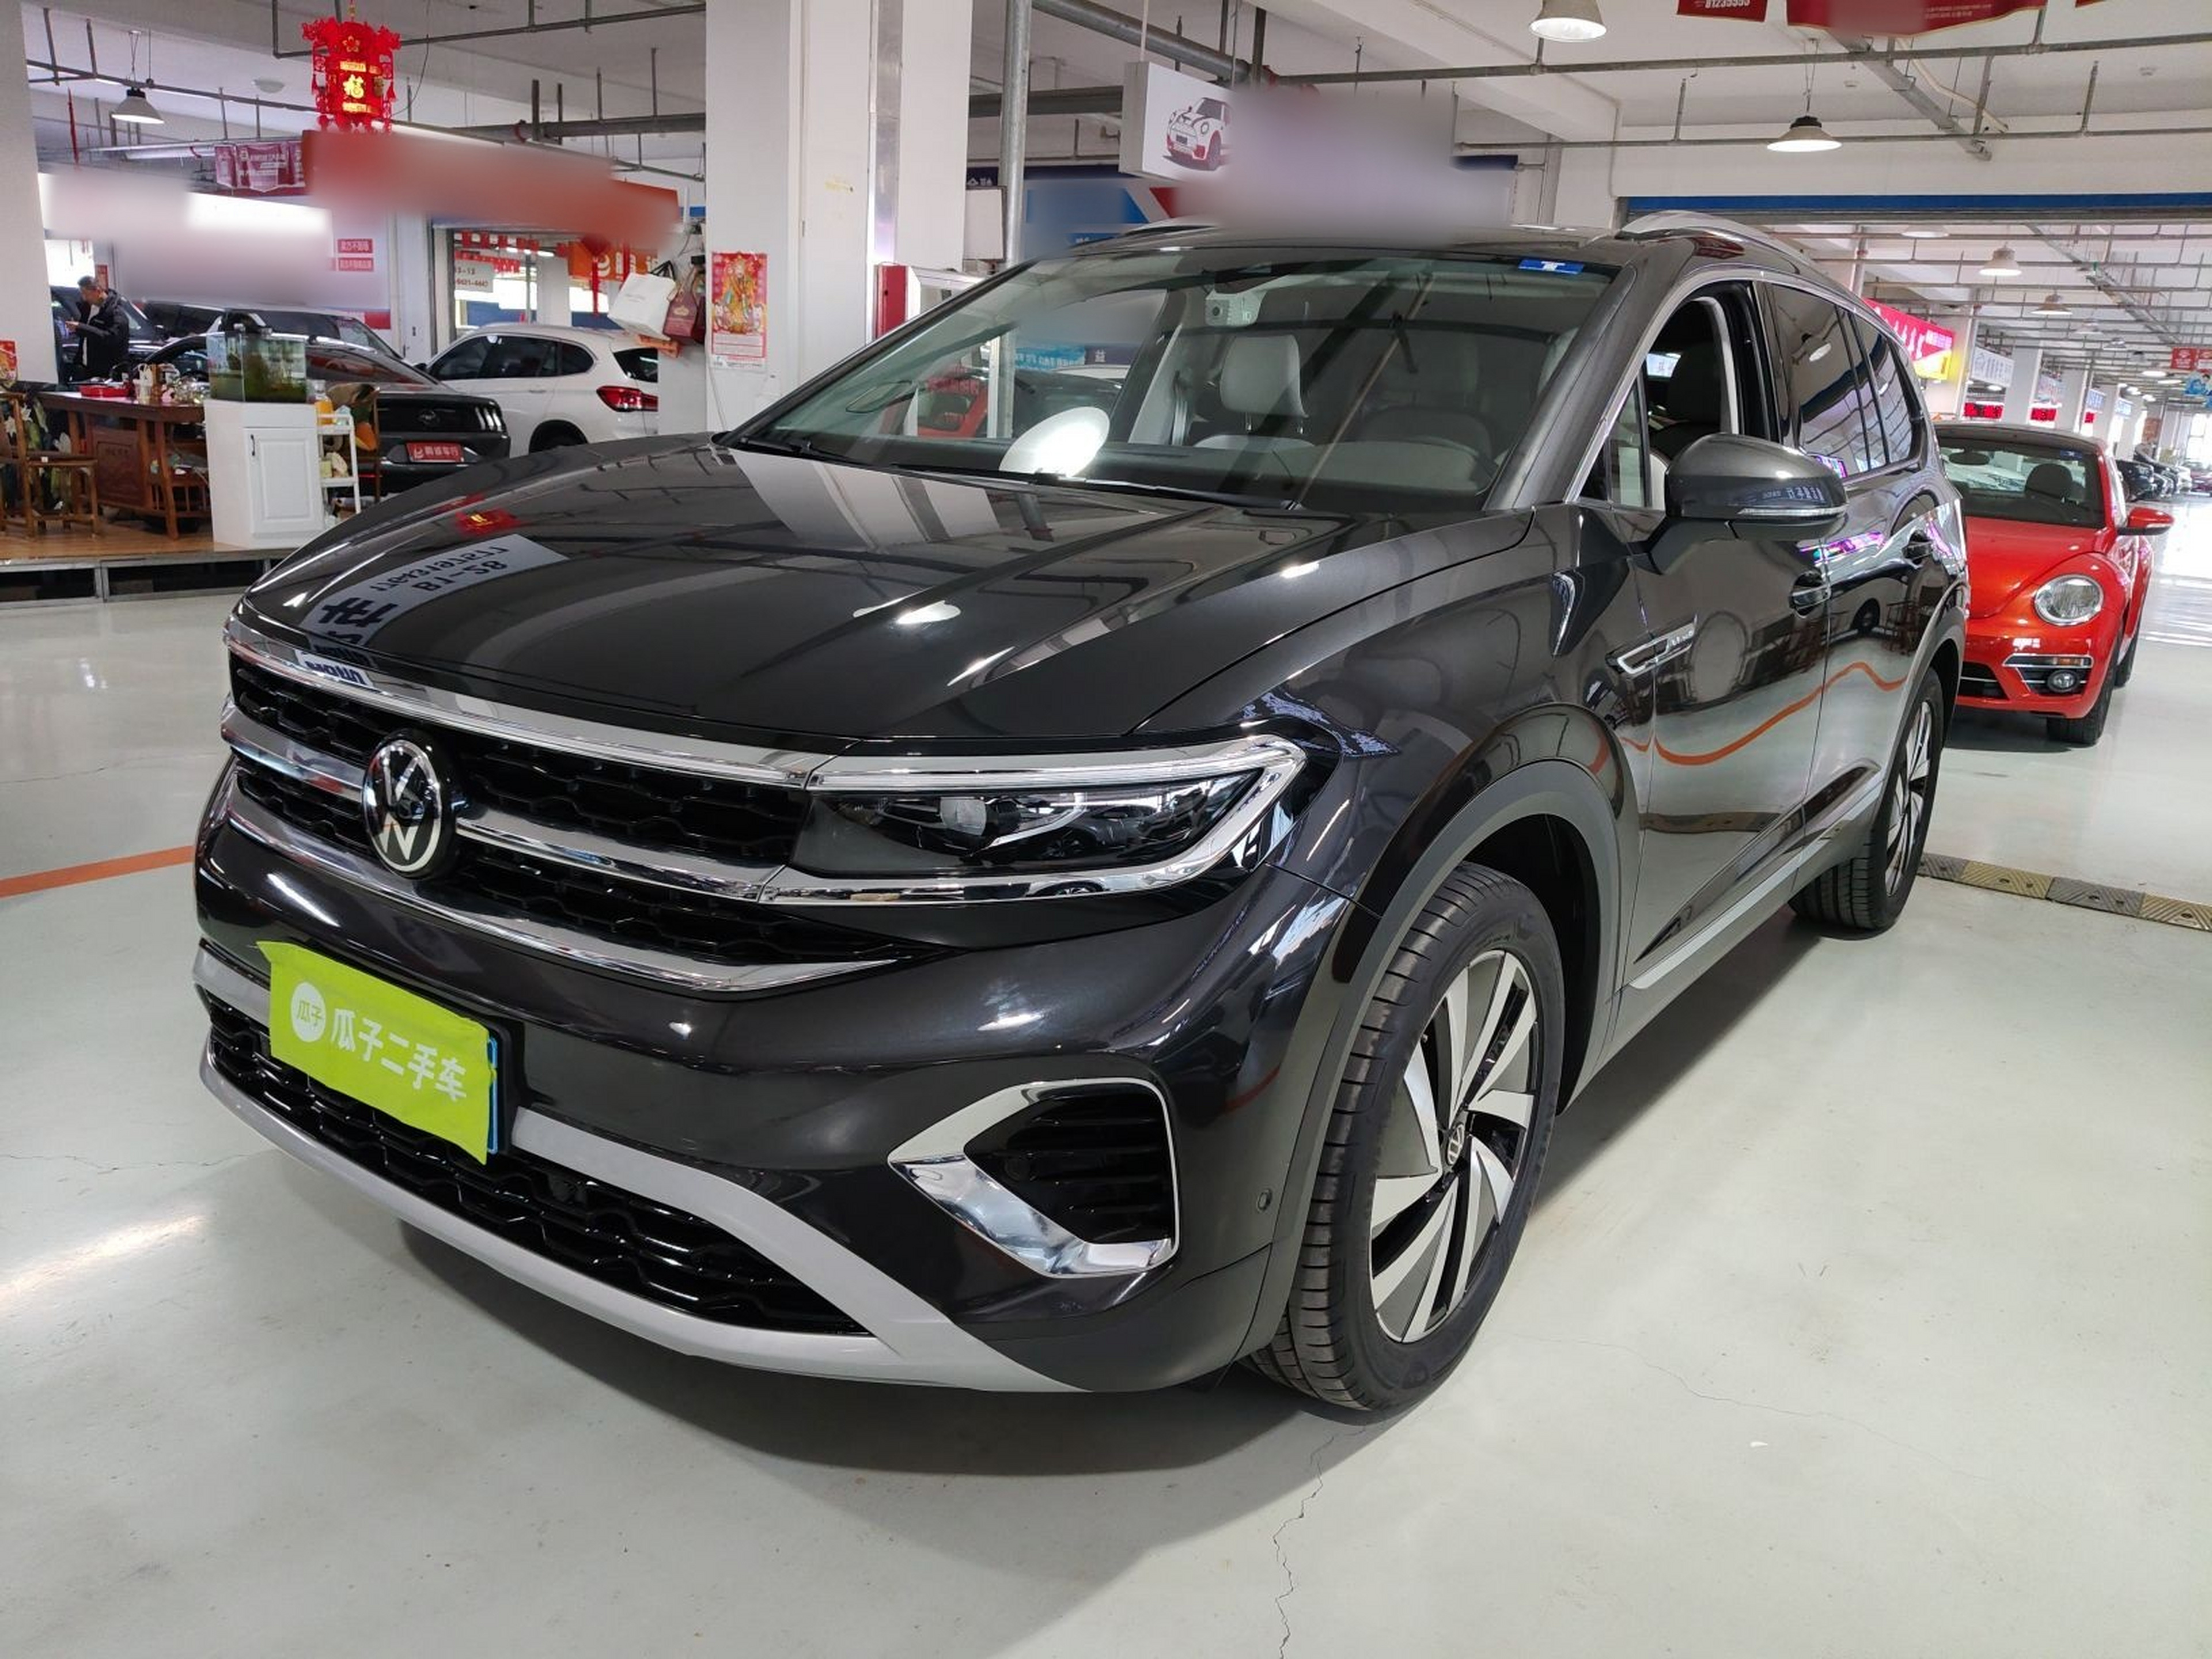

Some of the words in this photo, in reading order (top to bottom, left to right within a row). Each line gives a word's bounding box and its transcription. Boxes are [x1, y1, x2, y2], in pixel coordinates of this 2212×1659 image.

[296, 1000, 323, 1030] 瓜子
[331, 1008, 467, 1101] 瓜子二手车
